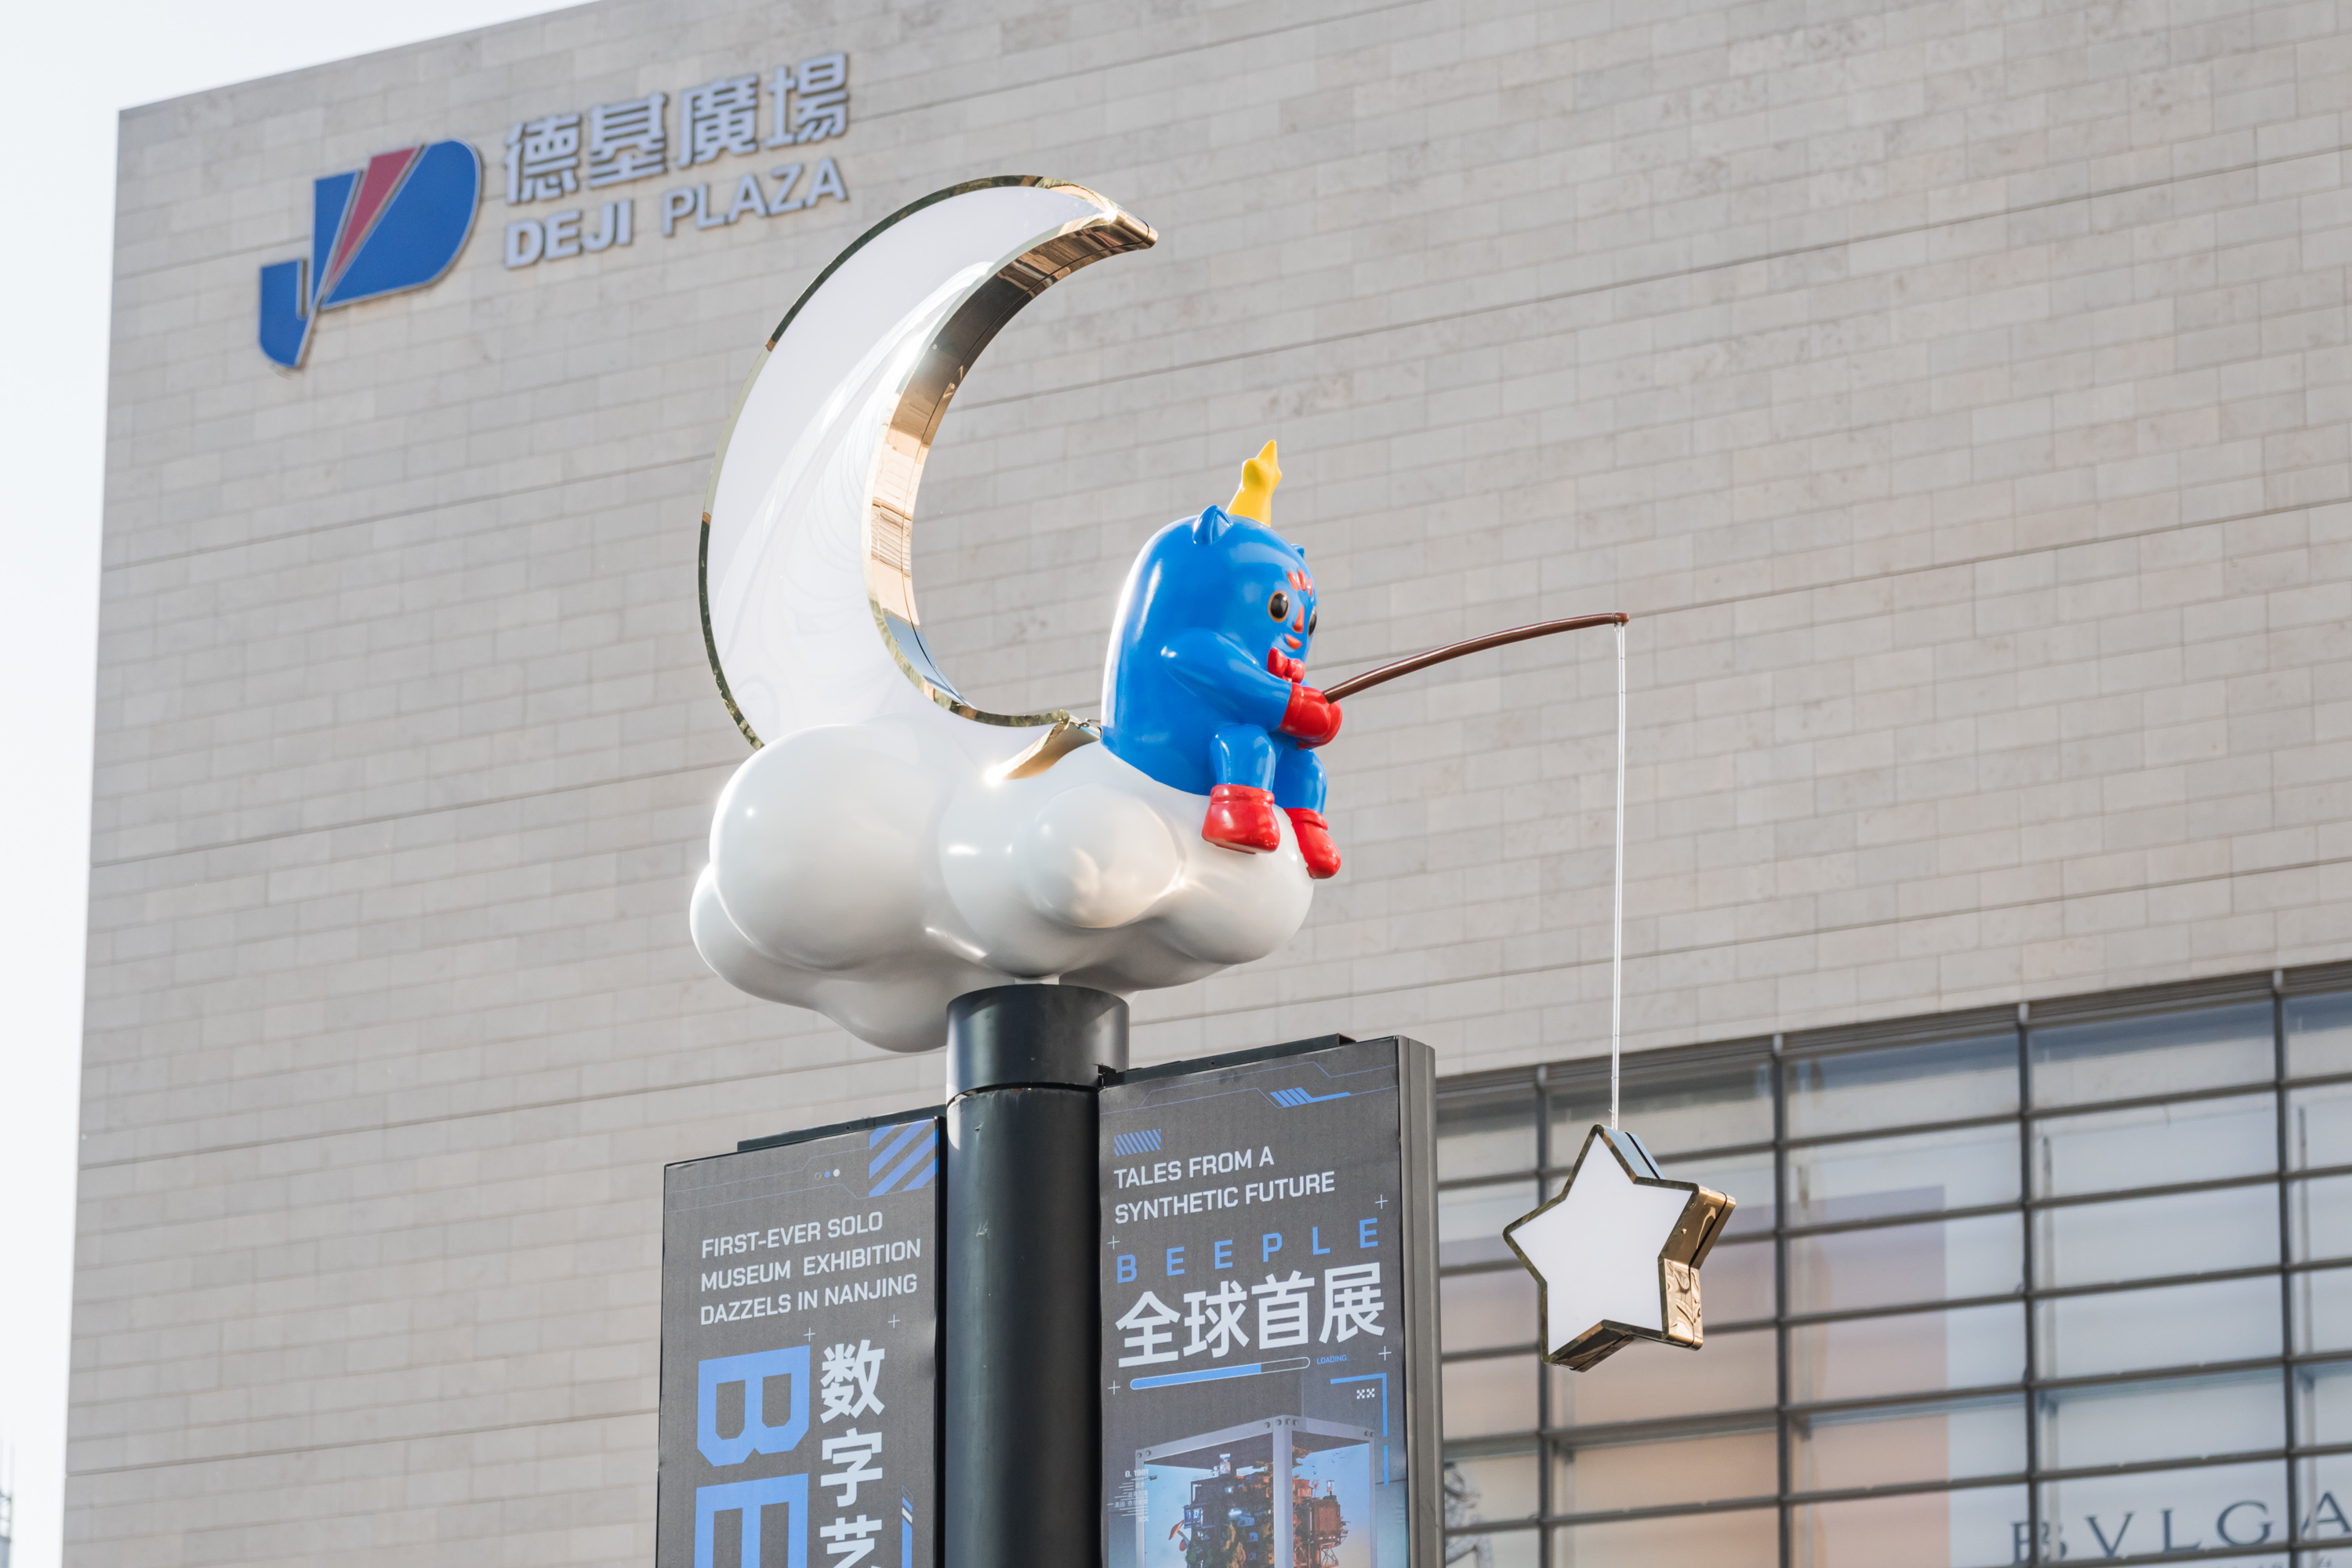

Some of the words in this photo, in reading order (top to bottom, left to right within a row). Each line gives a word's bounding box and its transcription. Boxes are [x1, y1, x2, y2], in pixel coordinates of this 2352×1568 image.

[505, 52, 849, 205] 德基廣場
[505, 198, 633, 270] DEJI
[663, 158, 848, 237] PLAZA
[1113, 1160, 1181, 1189] TALES
[1189, 1149, 1252, 1178] FROM
[1258, 1145, 1275, 1167] A
[1115, 1186, 1239, 1225] SYNTHETIC
[1245, 1171, 1335, 1205] FUTURE
[702, 1221, 821, 1258] FIRST-EVER
[827, 1211, 883, 1239] SOLO
[1116, 1218, 1378, 1283] BEEPLE
[701, 1260, 791, 1292] MUSEUM
[803, 1238, 921, 1276] EXHIBITION
[700, 1294, 791, 1326] DAZZELS
[798, 1289, 818, 1311] IN
[825, 1273, 917, 1307] NANJING
[1115, 1261, 1385, 1368] 全球首展
